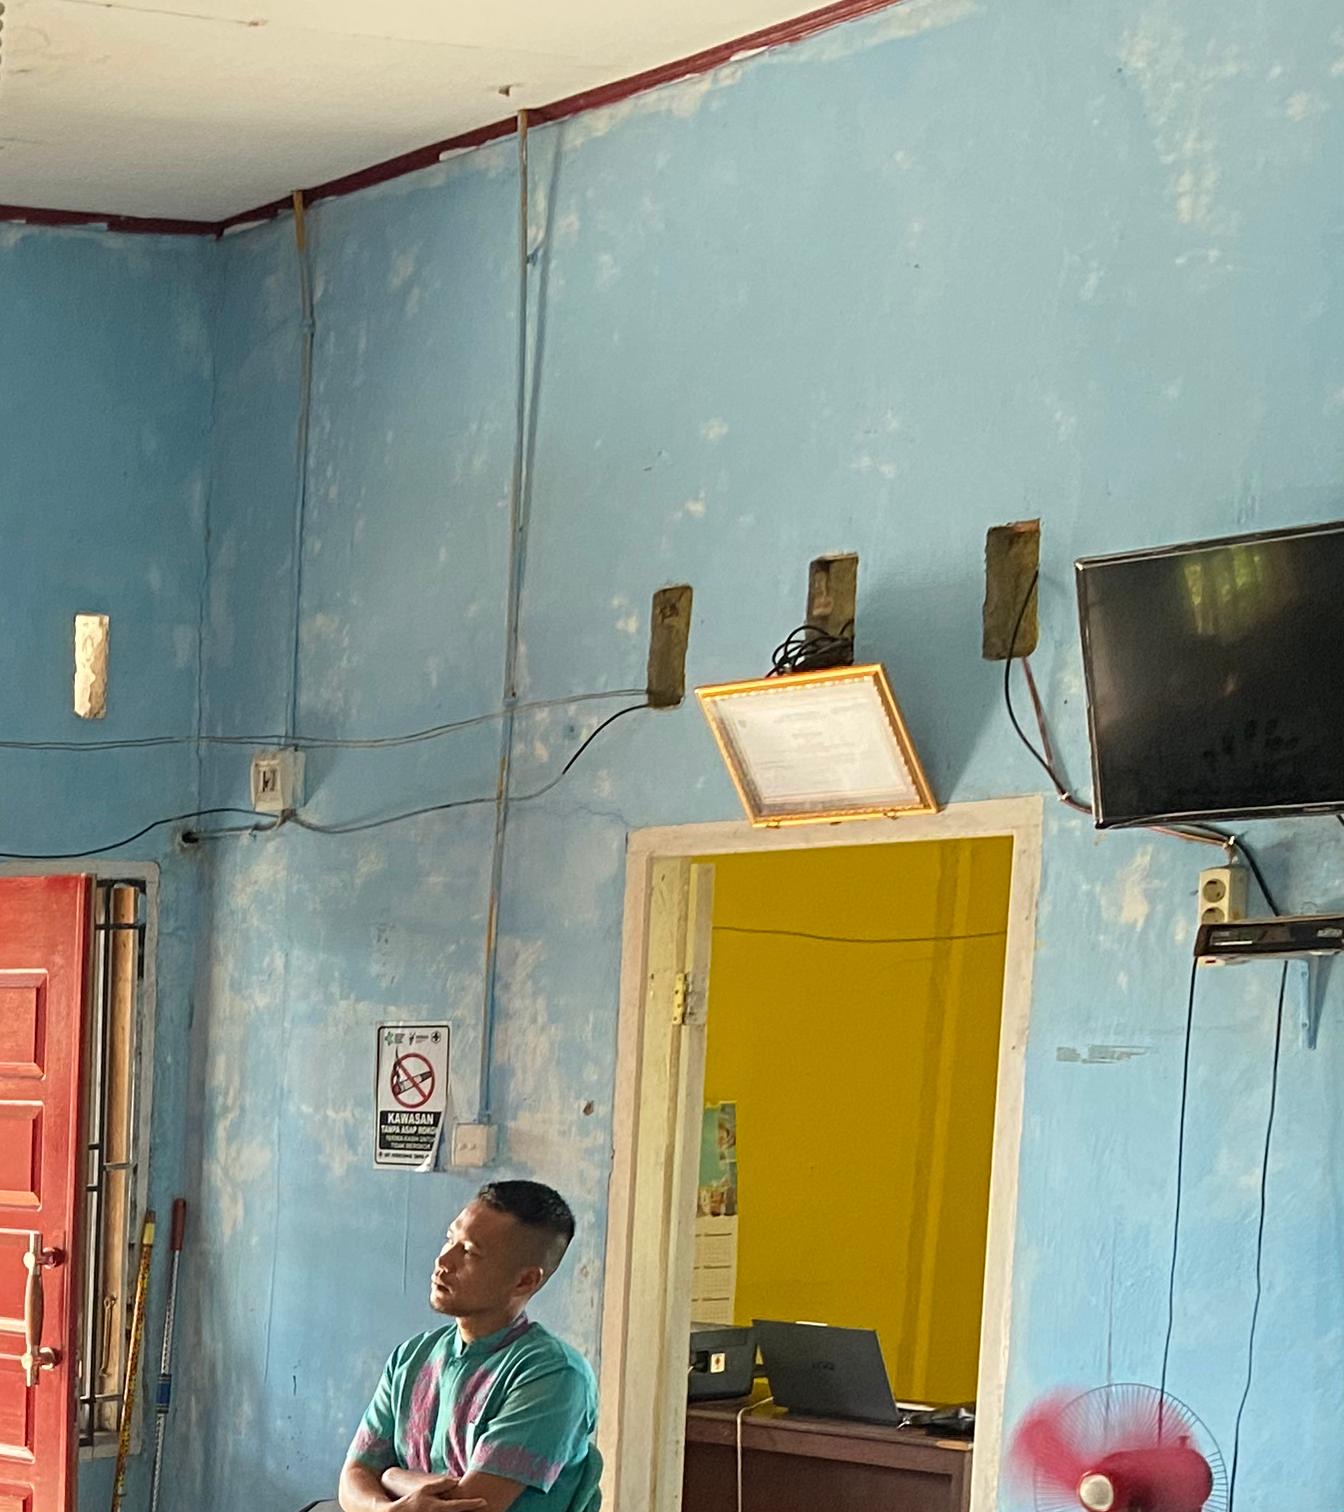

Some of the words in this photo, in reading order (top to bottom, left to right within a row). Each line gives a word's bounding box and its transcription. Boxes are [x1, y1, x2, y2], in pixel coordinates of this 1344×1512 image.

[387, 1112, 434, 1125] KAWASAN
[380, 1124, 401, 1134] TANPA
[401, 1125, 418, 1135] ASAP
